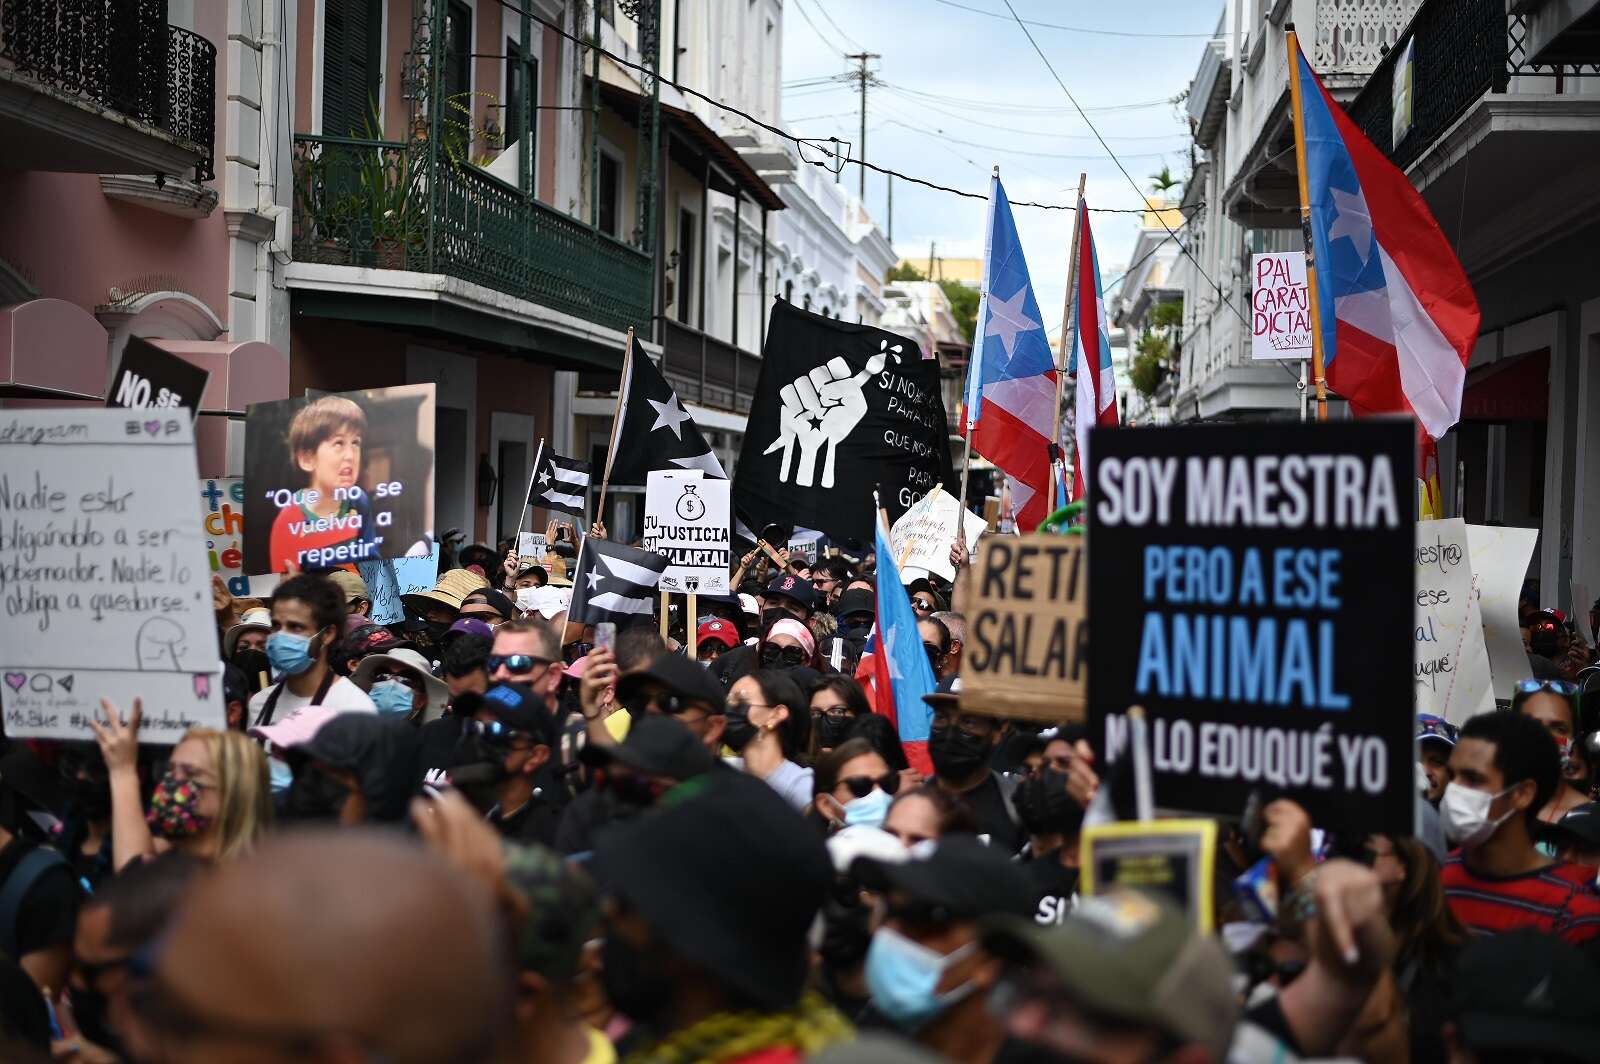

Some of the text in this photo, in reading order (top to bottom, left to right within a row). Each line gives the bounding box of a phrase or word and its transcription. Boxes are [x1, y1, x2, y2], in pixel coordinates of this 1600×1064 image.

[1257, 257, 1301, 288] PAL
[1253, 286, 1310, 313] CARAJ
[878, 370, 895, 391] SI
[897, 376, 915, 399] NO
[884, 429, 910, 451] QUE
[334, 485, 362, 502] no
[375, 480, 403, 498] se
[1096, 455, 1400, 528] SOY MAESTRA
[115, 528, 128, 545] a
[288, 511, 392, 535] vuelva a
[658, 525, 729, 542] JUSTICIA
[111, 554, 165, 584] Nadie
[981, 543, 1083, 602] RETI
[1144, 544, 1342, 609] PERO A ESE
[66, 592, 80, 609] a
[1416, 589, 1450, 607] ese
[1415, 616, 1438, 643] al
[1134, 611, 1352, 710] ANIMAL
[1415, 655, 1453, 692] uqué
[1154, 717, 1194, 773] LO
[1199, 721, 1333, 788] EDUQUÉ
[1338, 734, 1388, 792] YO
